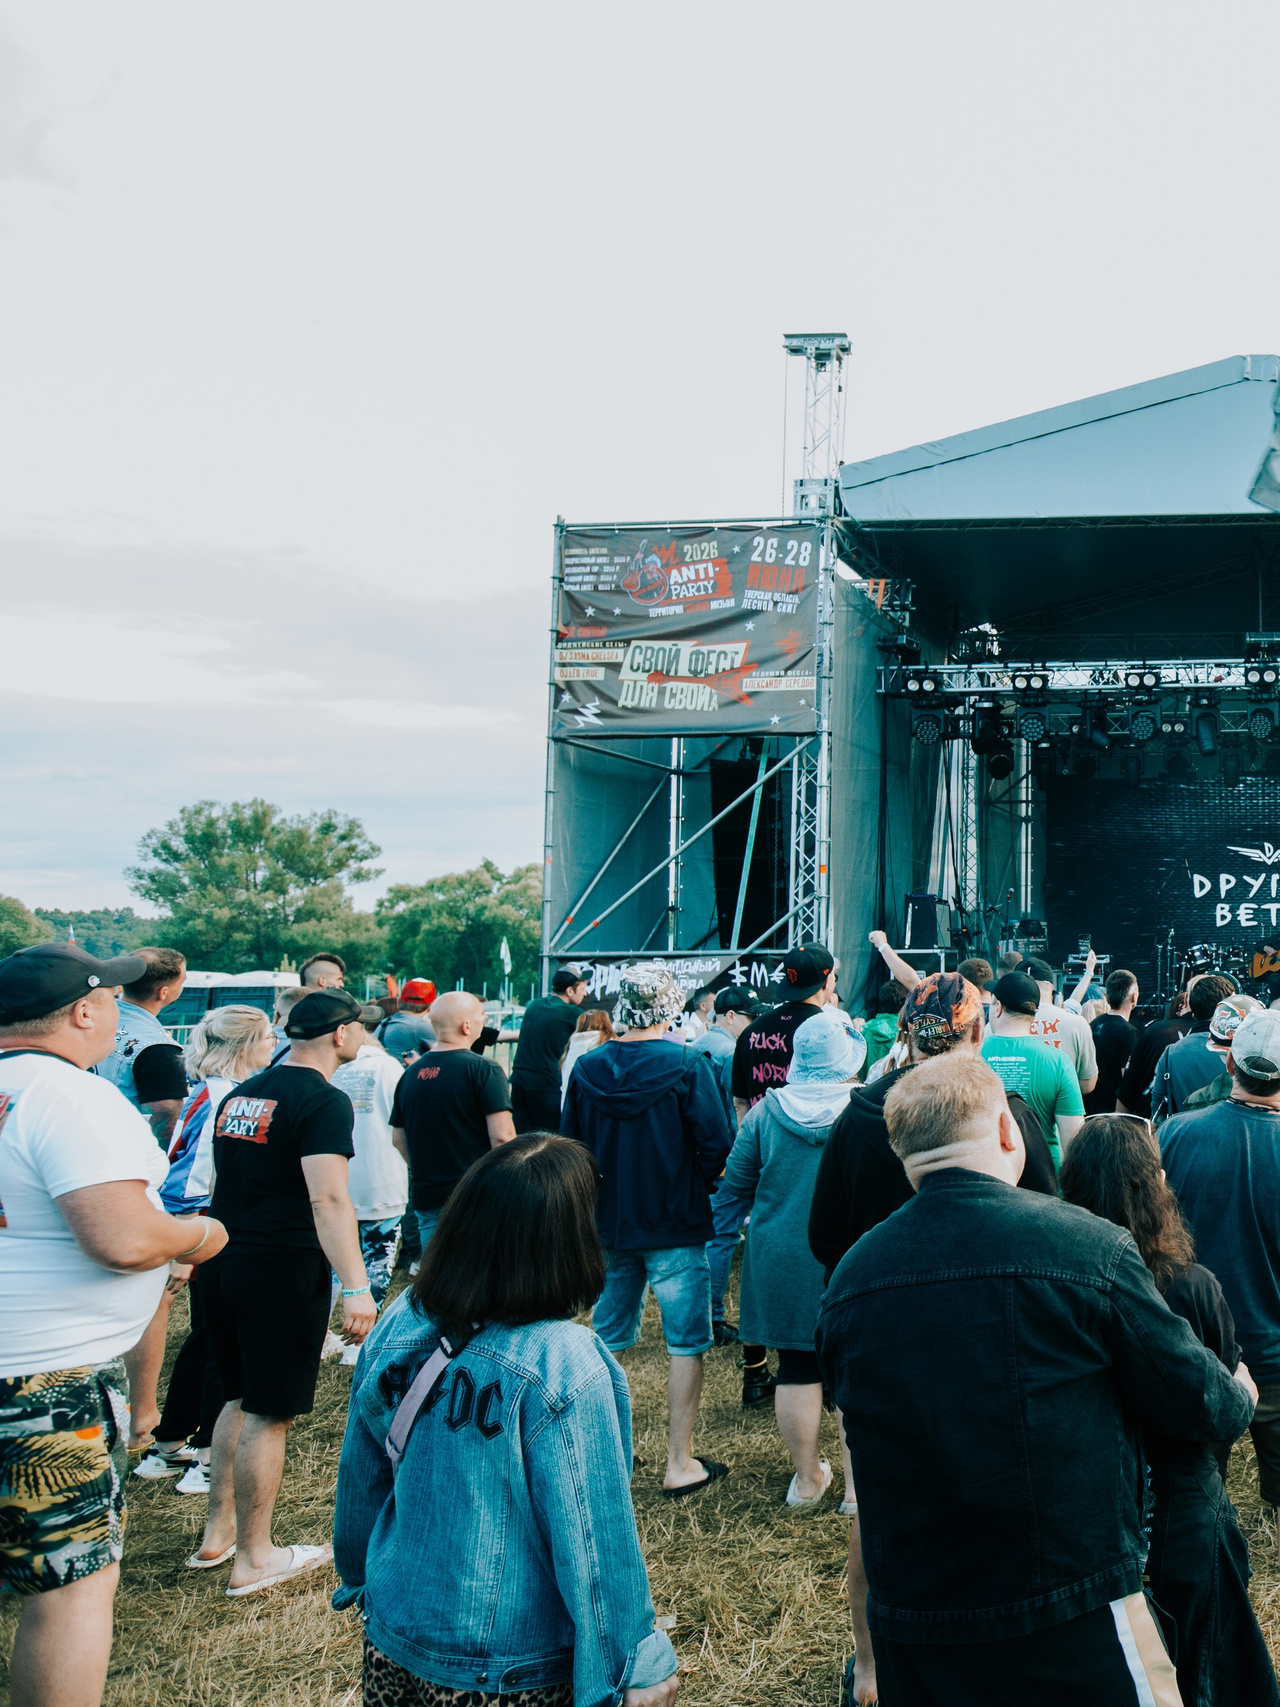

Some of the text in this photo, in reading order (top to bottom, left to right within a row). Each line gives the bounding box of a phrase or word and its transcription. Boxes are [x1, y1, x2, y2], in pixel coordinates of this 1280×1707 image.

[683, 540, 719, 562] 2026
[669, 562, 720, 585] ANTI-
[746, 562, 806, 594] ИЮНЯ
[670, 580, 714, 600] PARTY
[568, 651, 590, 661] SASHA
[591, 650, 619, 661] CHELSEA
[629, 643, 681, 677] СВОЙ
[617, 680, 659, 709] ДЛЯ
[744, 679, 783, 689] АЛЕКСАНДР
[749, 1031, 788, 1053] FUCK
[226, 1099, 269, 1119] ANTI-
